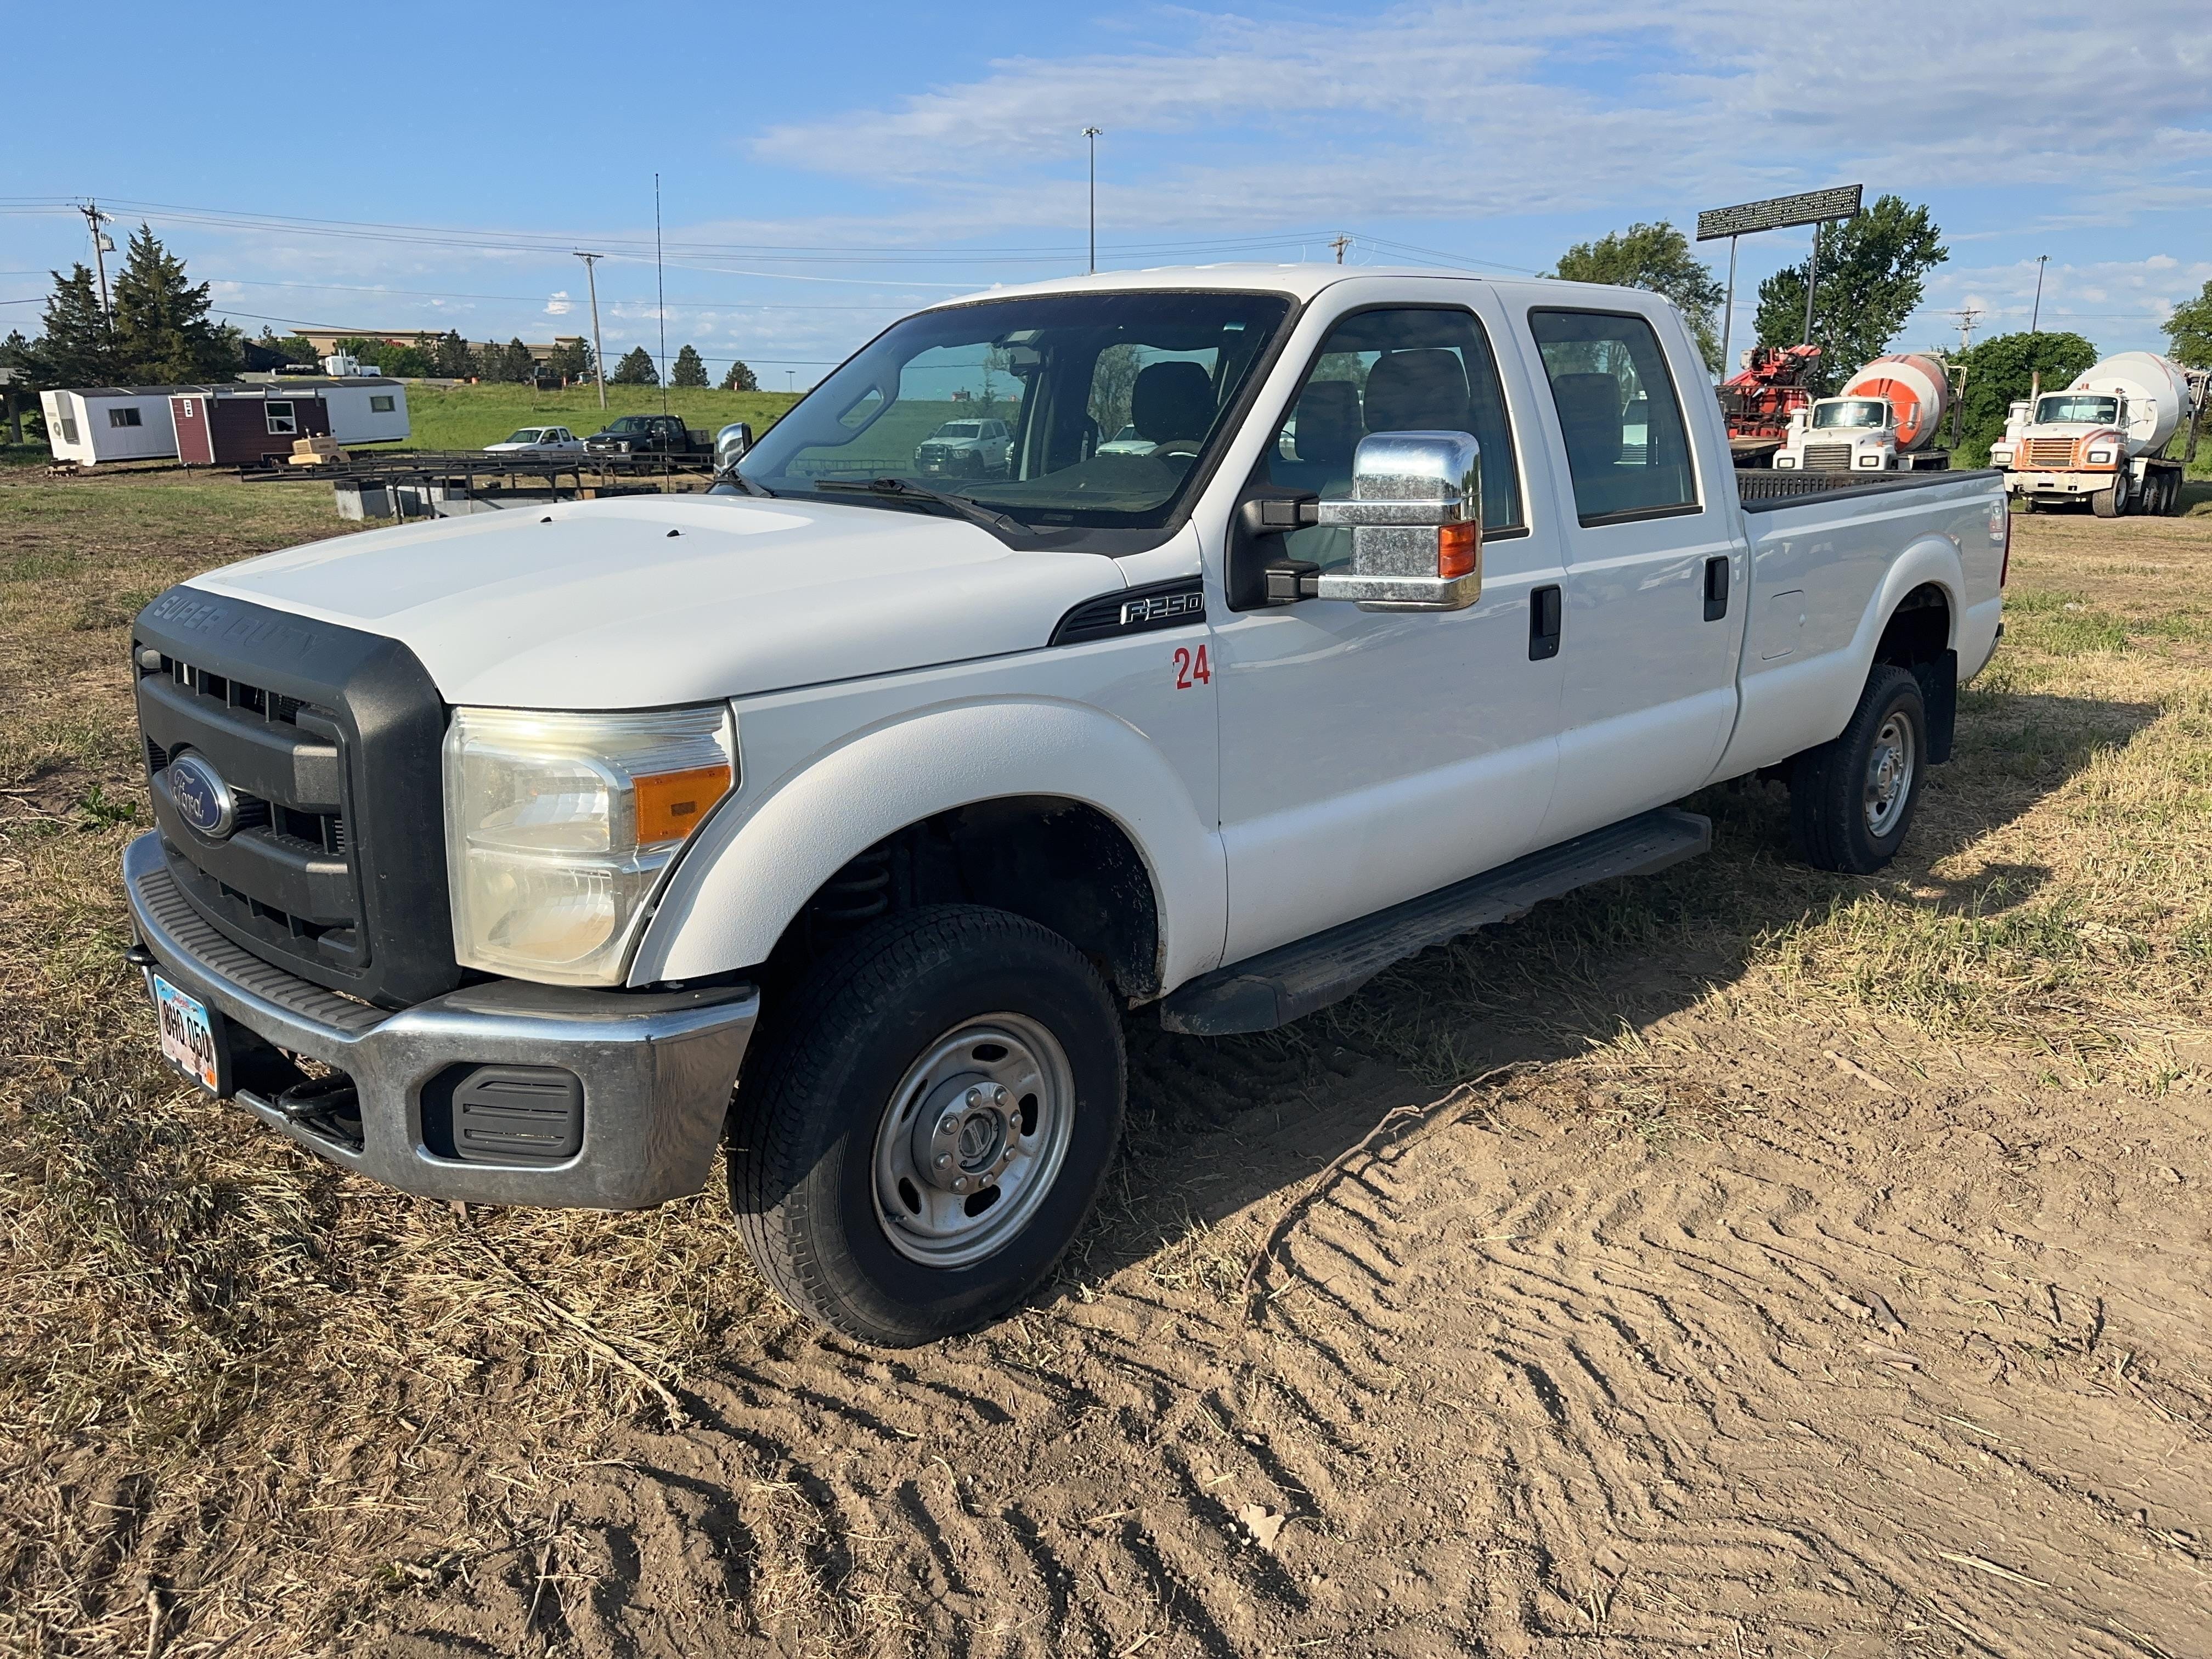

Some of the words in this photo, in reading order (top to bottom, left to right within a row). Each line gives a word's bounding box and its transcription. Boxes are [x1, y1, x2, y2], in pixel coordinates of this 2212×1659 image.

[153, 595, 227, 634] SUPER
[221, 615, 336, 660] DUTY
[1120, 592, 1204, 625] F-250
[1174, 645, 1210, 690] 24
[173, 769, 204, 820] Ford
